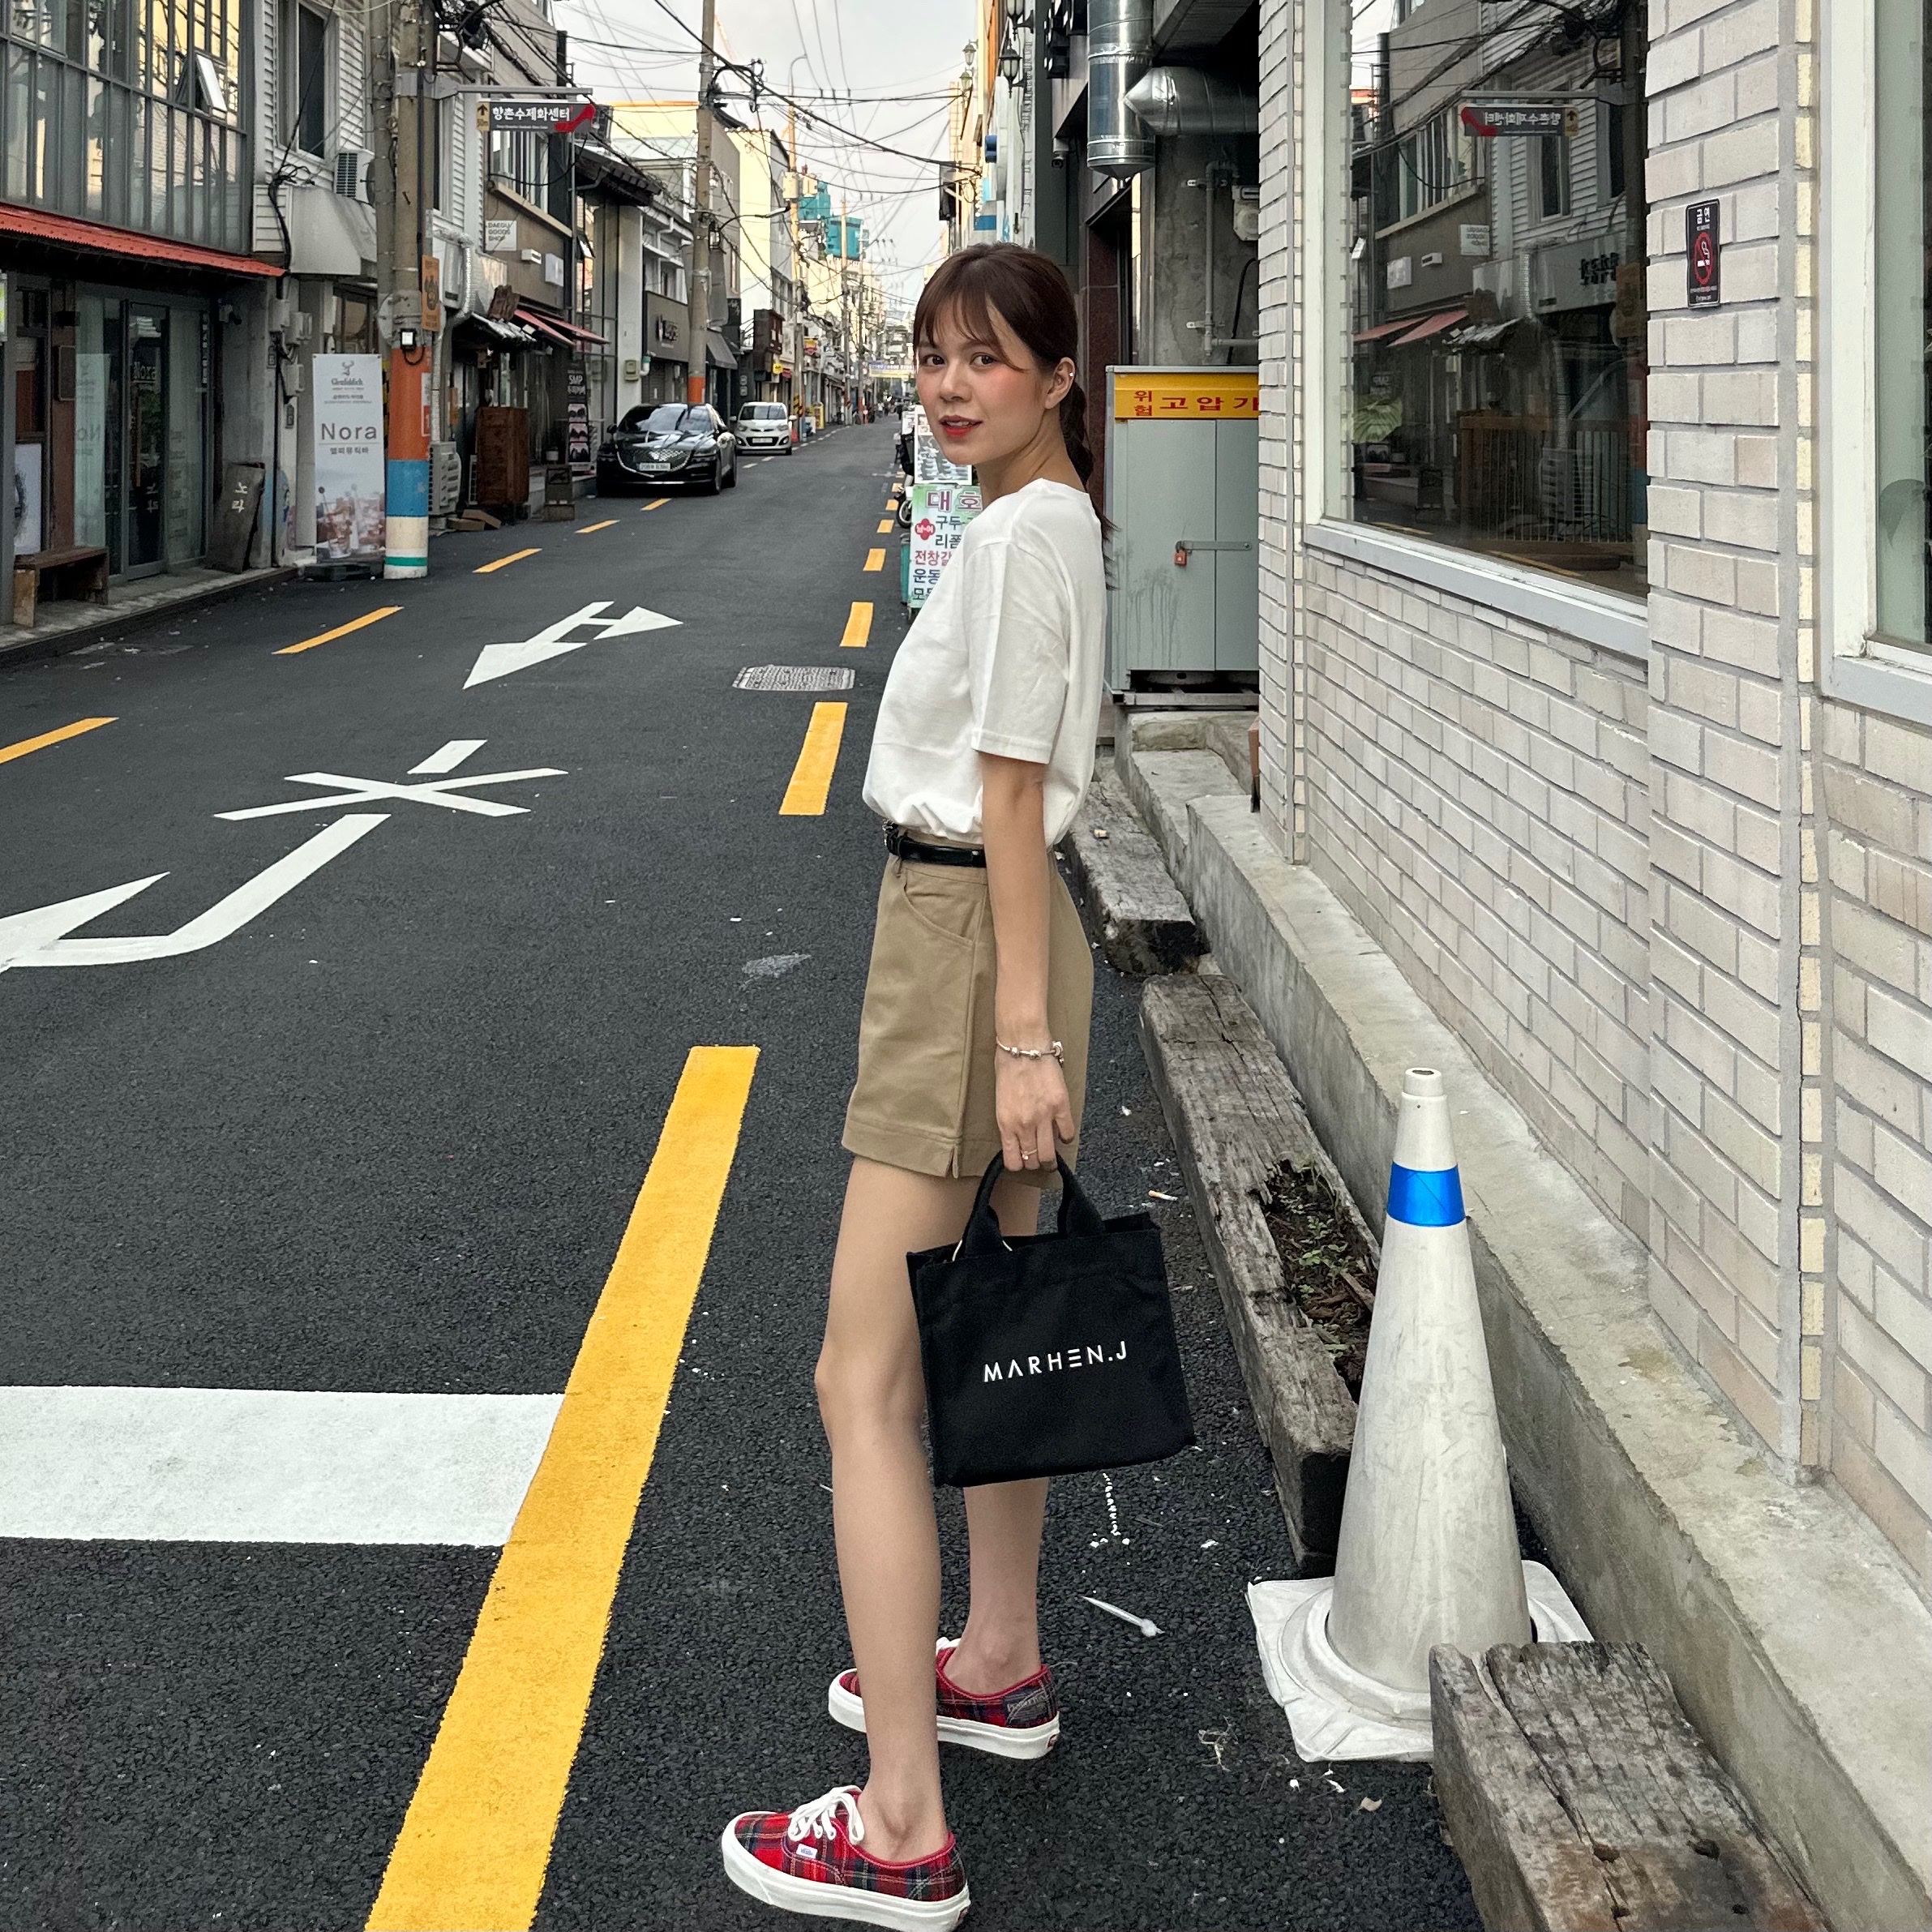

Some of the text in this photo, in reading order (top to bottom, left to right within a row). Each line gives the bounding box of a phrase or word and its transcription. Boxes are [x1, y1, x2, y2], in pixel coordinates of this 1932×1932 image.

[492, 106, 570, 122] 향촌수제화센터
[1696, 207, 1711, 225] 금연
[1134, 390, 1153, 416] 위험
[321, 423, 378, 440] Nora
[927, 490, 982, 511] 대호
[983, 1340, 1127, 1382] MARHEN.J
